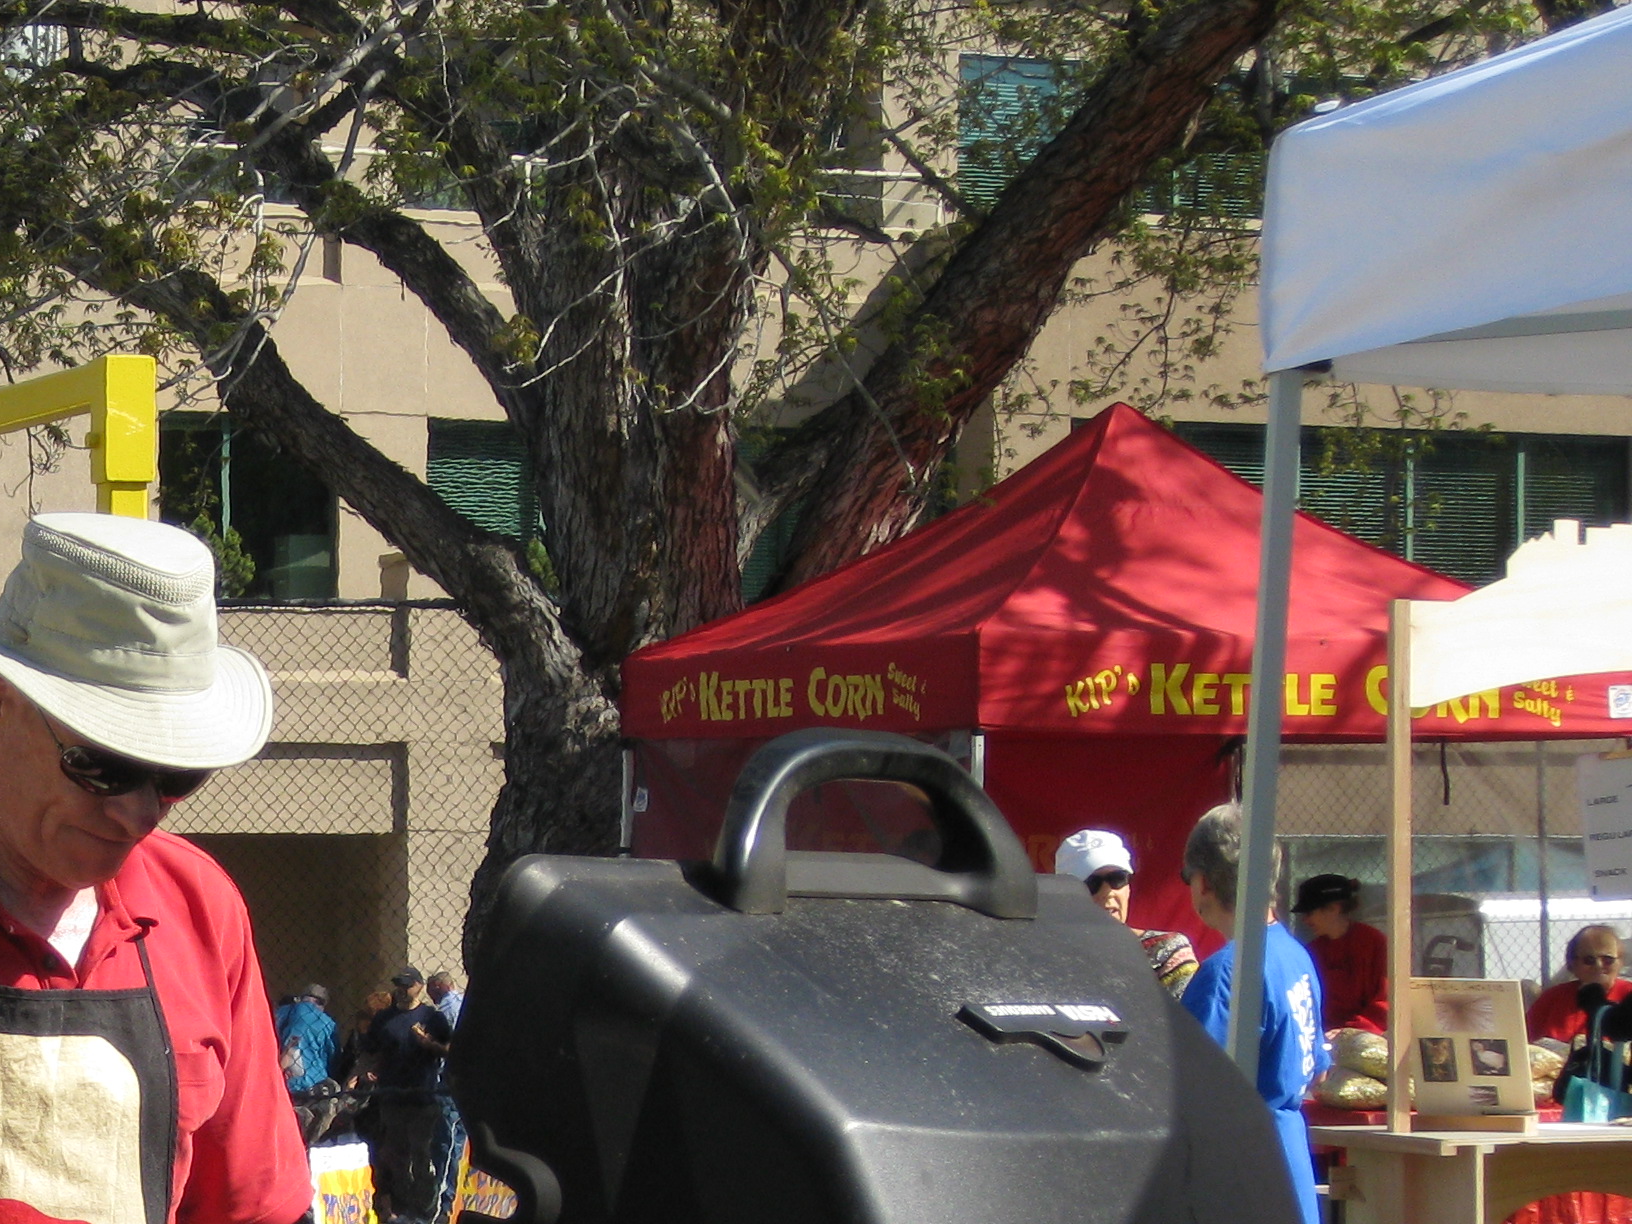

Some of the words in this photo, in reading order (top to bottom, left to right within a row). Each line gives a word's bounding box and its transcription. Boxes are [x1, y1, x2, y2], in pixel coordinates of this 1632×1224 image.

[699, 671, 794, 721] KETTLE
[807, 666, 886, 722] CORN
[887, 662, 917, 692] Sweet
[891, 687, 921, 722] Salty
[1150, 662, 1338, 717] KETLE
[1513, 691, 1562, 728] Salty
